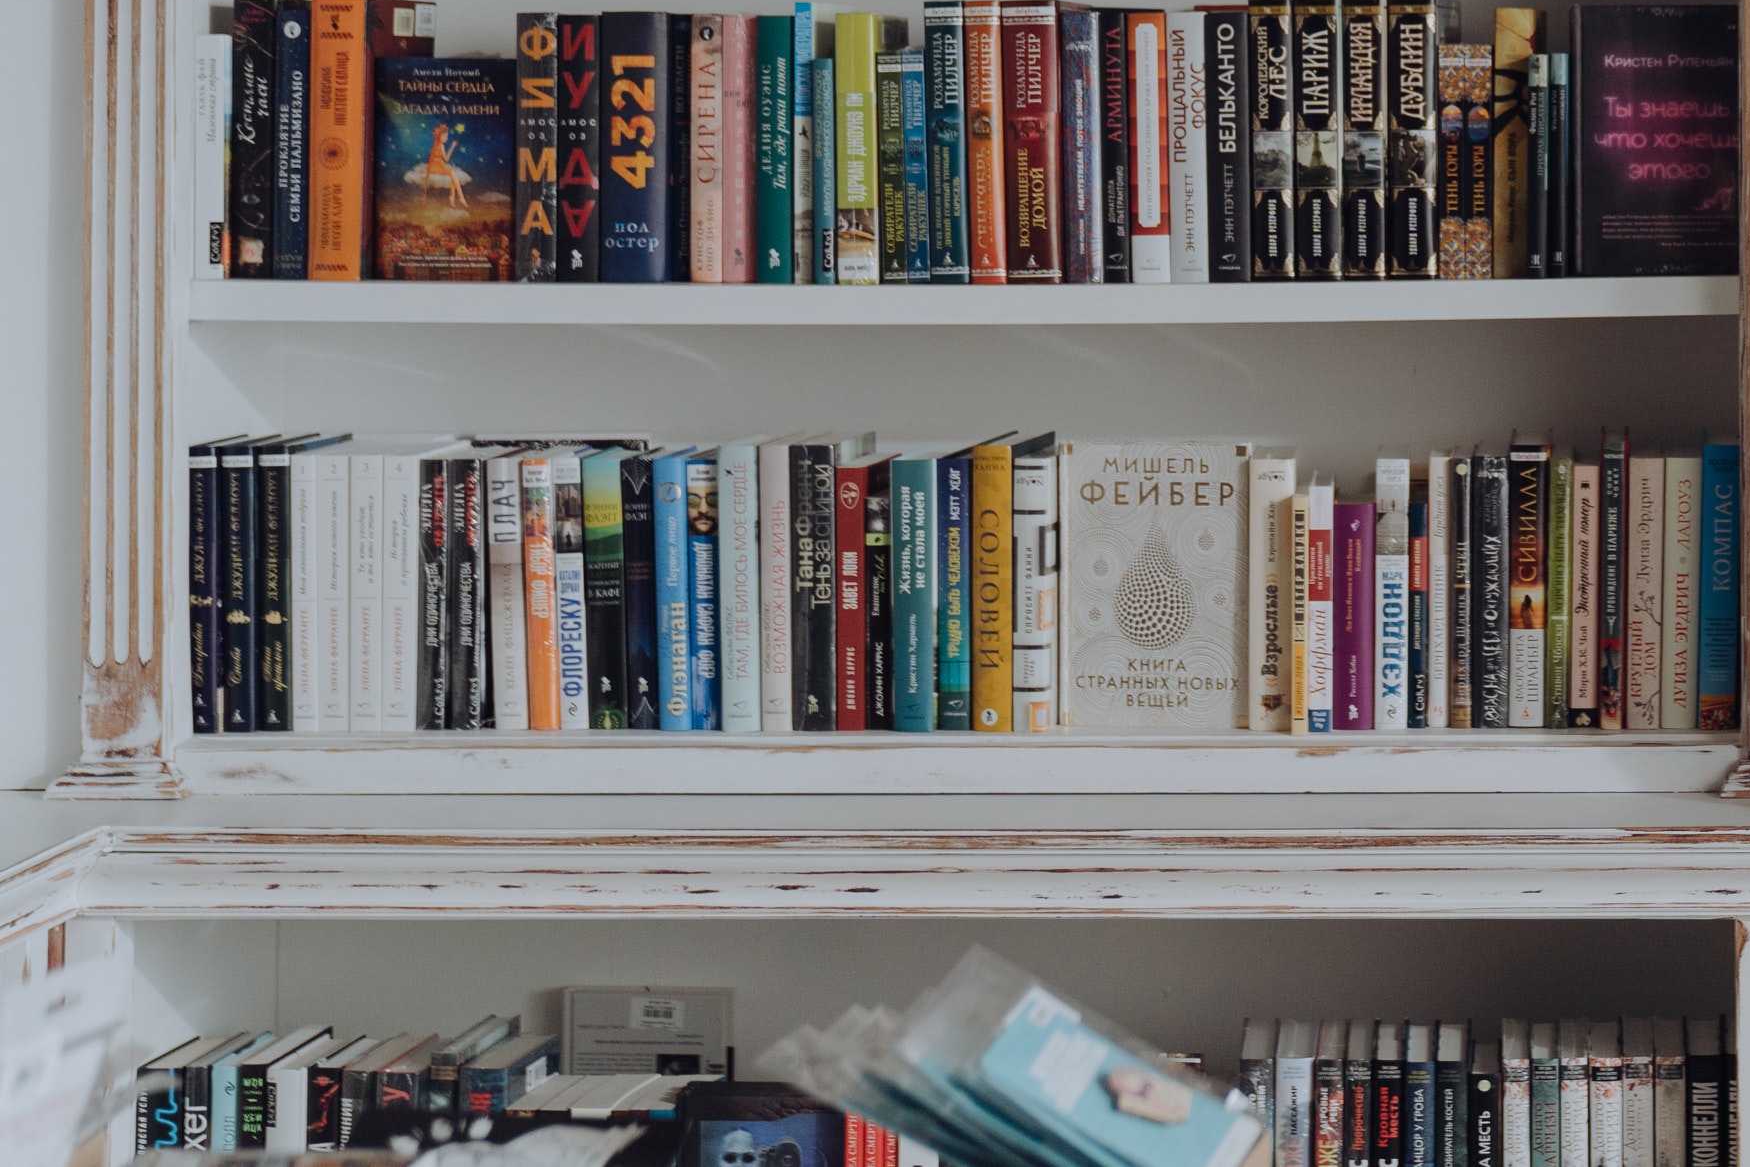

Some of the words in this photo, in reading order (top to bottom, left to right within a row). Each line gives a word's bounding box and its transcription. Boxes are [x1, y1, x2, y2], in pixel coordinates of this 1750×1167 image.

[774, 57, 786, 94] поют
[1016, 32, 1027, 108] РОЗАМУНДА
[1028, 33, 1042, 104] ПИЛЧЕР
[1105, 27, 1122, 142] АРМИНУТА
[1170, 29, 1188, 163] ПРОЩАЛЬНЫЙ
[1190, 62, 1206, 129] ФОКУС
[1217, 23, 1236, 153] БЕЛЬКАНТО
[279, 105, 290, 188] ПРОКЛЯТИЕ
[291, 71, 303, 169] ПАЛЬМИЗАНО
[611, 54, 655, 189] 4321
[698, 59, 717, 184] СИРЕНА
[774, 136, 787, 156] где
[775, 98, 790, 134] раки
[774, 162, 788, 190] Там,
[1473, 145, 1485, 177] ГОРЫ
[290, 174, 301, 223] СЕМЬИ
[1017, 148, 1030, 247] ВОЗВРАЩЕНИЕ
[1030, 167, 1047, 229] ДОМОЙ
[1474, 181, 1485, 214] ТЕНЬ
[1080, 476, 1234, 507] ФЕЙБЕР
[1102, 457, 1209, 475] МИШЕЛЬ
[492, 479, 517, 544] ПЛАЧ
[900, 486, 913, 541] которая
[913, 491, 926, 526] моей
[1520, 466, 1537, 582] СИВИЛЛА
[1676, 478, 1691, 550] ЛАРОУЗ
[1713, 483, 1734, 593] КОМПАС
[842, 551, 858, 577] ЛОКИ
[899, 544, 912, 594] Жизнь,
[915, 529, 926, 568] стала
[843, 580, 859, 610] ЗАВЕТ
[915, 572, 925, 588] не
[978, 508, 1005, 669] СОЛОВЕЙ
[1675, 573, 1690, 643] ЭРДРИЧ
[560, 597, 584, 697] ФЛОРЕСКУ
[666, 601, 689, 717] Флэнаган
[1128, 658, 1187, 672] КНИГА
[1310, 609, 1332, 697] Хоффман
[1381, 583, 1406, 698] ХЭДДОН
[1075, 675, 1170, 691] СТРАННЫХ
[1178, 675, 1242, 691] НОВЫХ
[1126, 692, 1188, 708] ВЕЩЕЙ
[1673, 647, 1687, 709] ЛУИЗА
[1352, 1086, 1365, 1150] Пророчество
[1378, 1087, 1389, 1147] Кровная
[1388, 1095, 1399, 1138] месть
[1692, 1082, 1719, 1167] КОННЕЛЛИ
